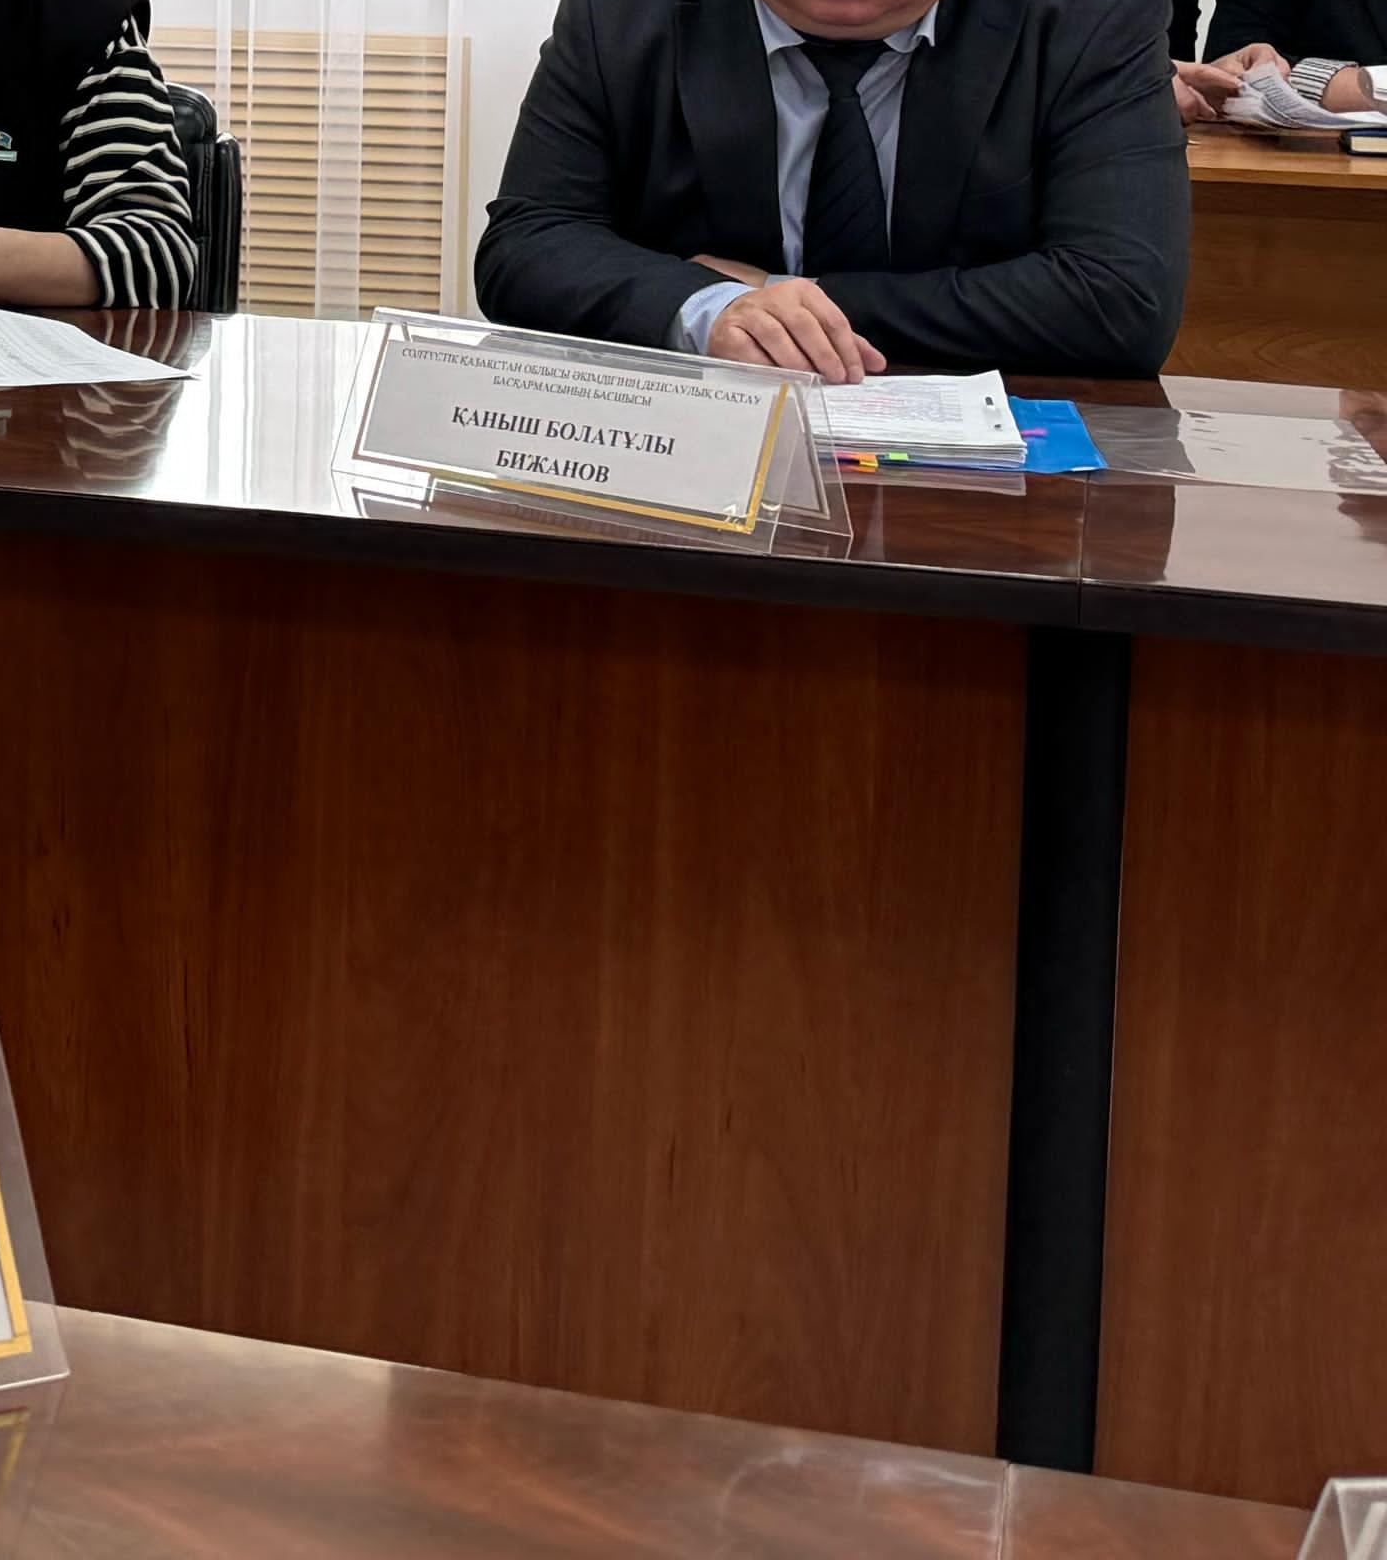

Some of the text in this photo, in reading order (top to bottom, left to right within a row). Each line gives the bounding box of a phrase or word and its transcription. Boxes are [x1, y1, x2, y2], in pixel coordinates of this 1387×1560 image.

[452, 406, 676, 456] ҚАНЫШ БОЛАТҰЛЫ
[495, 449, 611, 483] БИЖАНОВ
